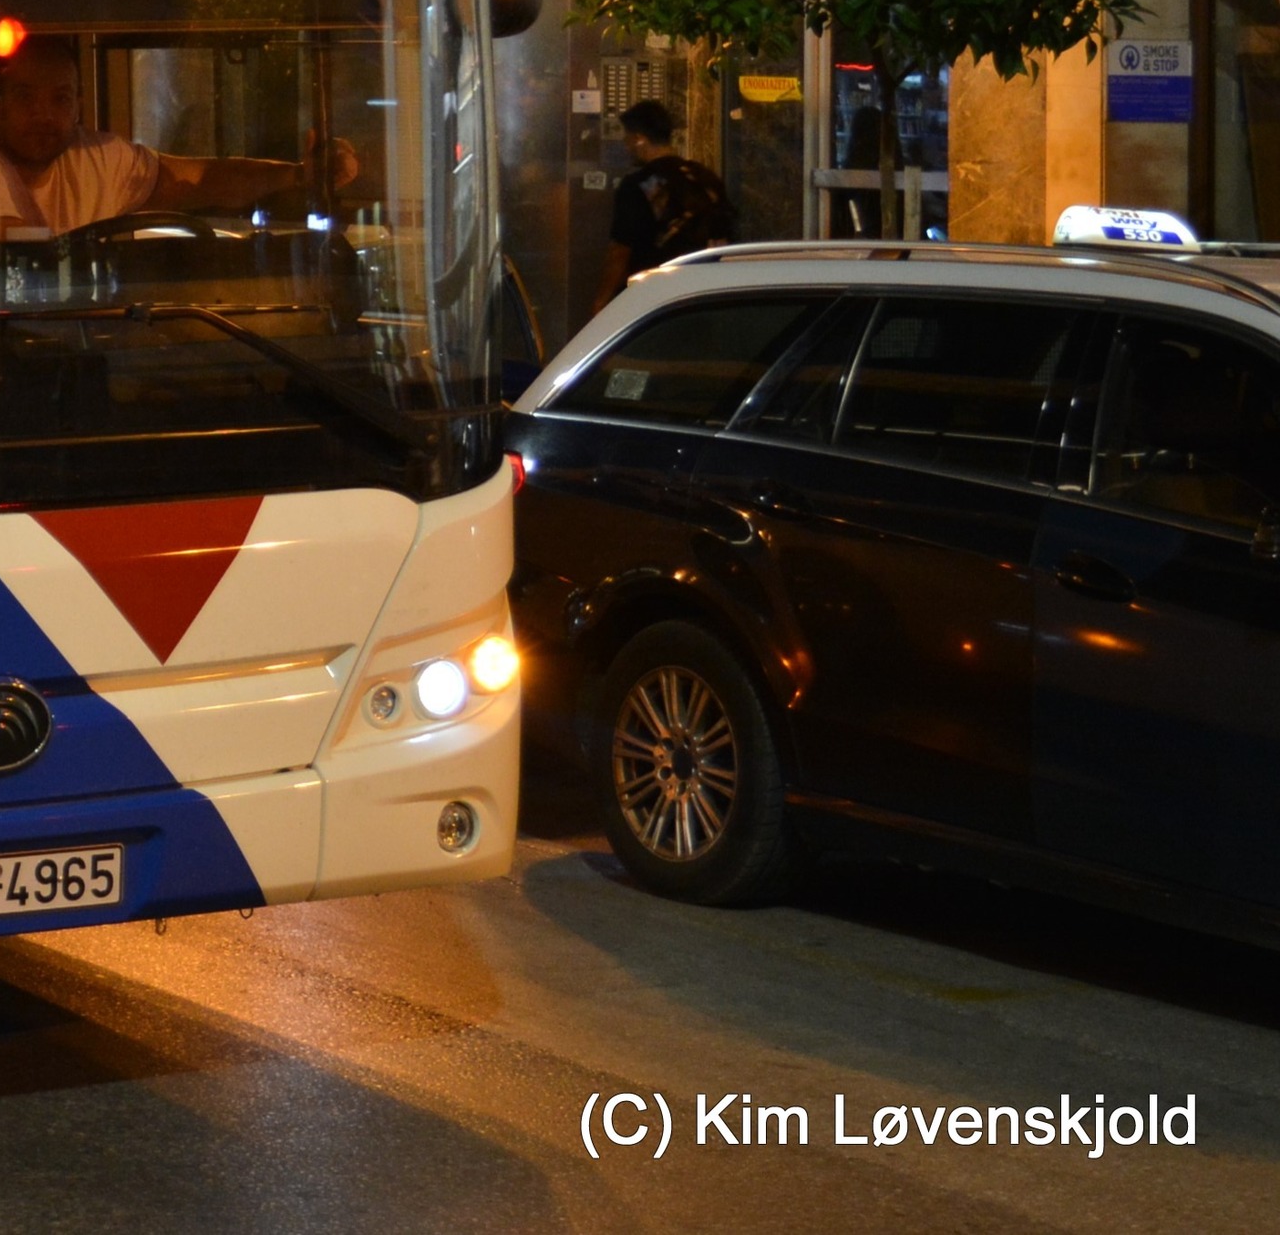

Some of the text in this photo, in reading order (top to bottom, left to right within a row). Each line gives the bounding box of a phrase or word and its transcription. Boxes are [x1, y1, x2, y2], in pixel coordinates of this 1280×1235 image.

[1143, 45, 1179, 58] SMOKE
[1143, 59, 1179, 71] & STOP
[1124, 229, 1162, 242] 530
